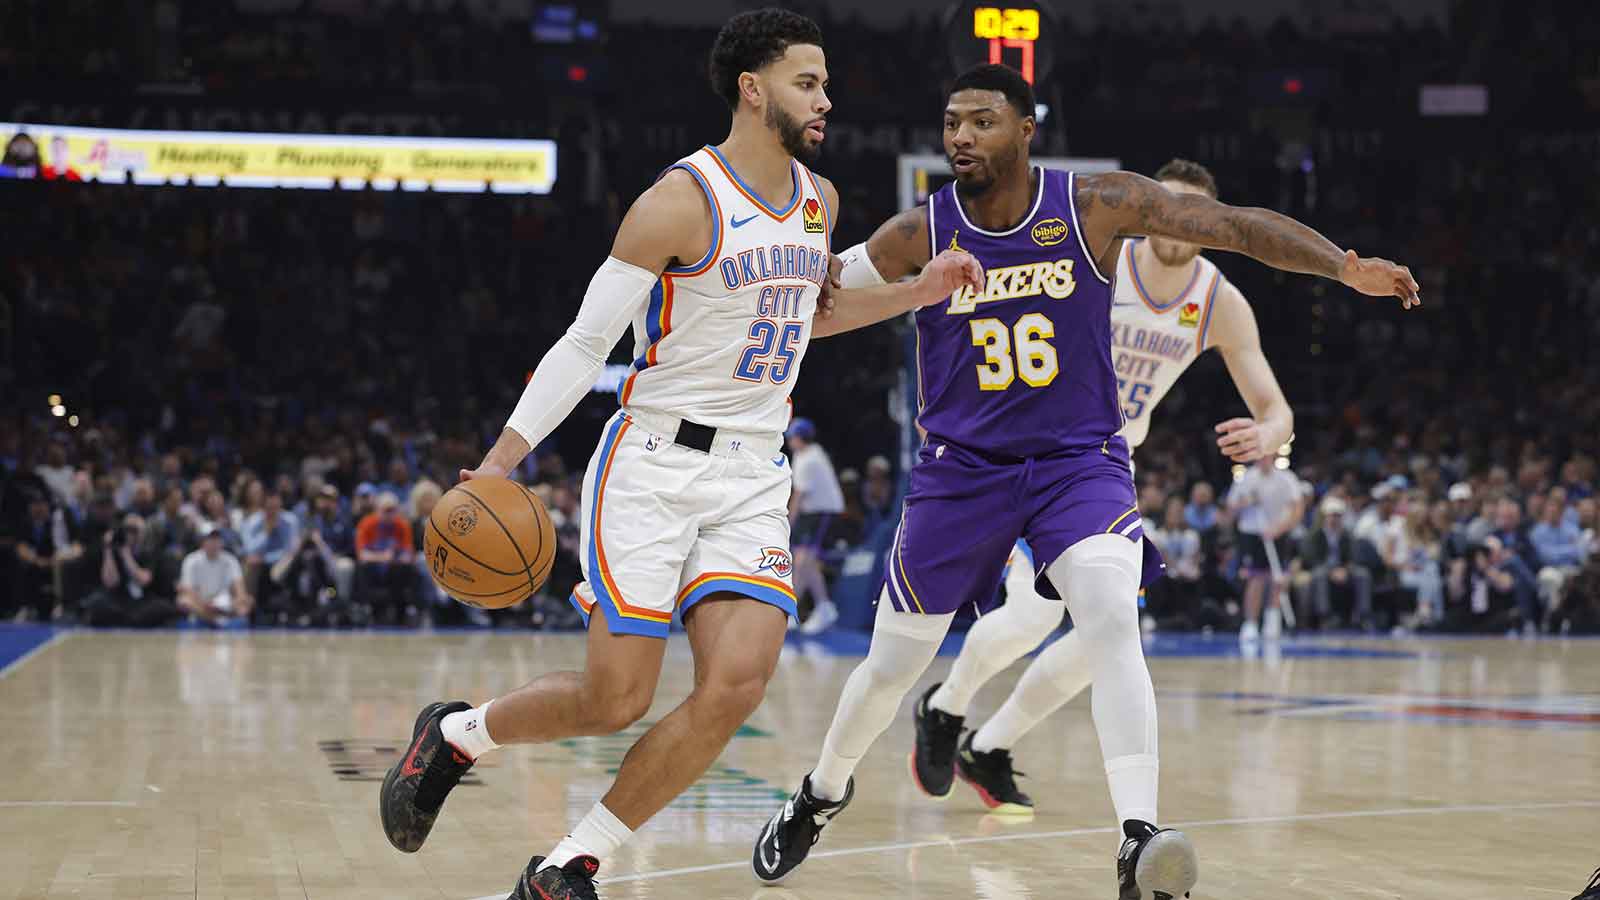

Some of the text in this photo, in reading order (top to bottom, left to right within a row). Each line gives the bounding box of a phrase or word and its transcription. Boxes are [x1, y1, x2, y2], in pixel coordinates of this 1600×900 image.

[158, 143, 247, 172] Heating
[276, 147, 382, 172] Plumbing
[411, 152, 540, 172] Generators
[1034, 225, 1066, 237] bibigo
[720, 245, 827, 290] OKLAHOMA
[757, 285, 806, 318] CITY
[733, 319, 804, 384] 25
[968, 312, 1060, 391] 36
[1116, 352, 1162, 380] CITY
